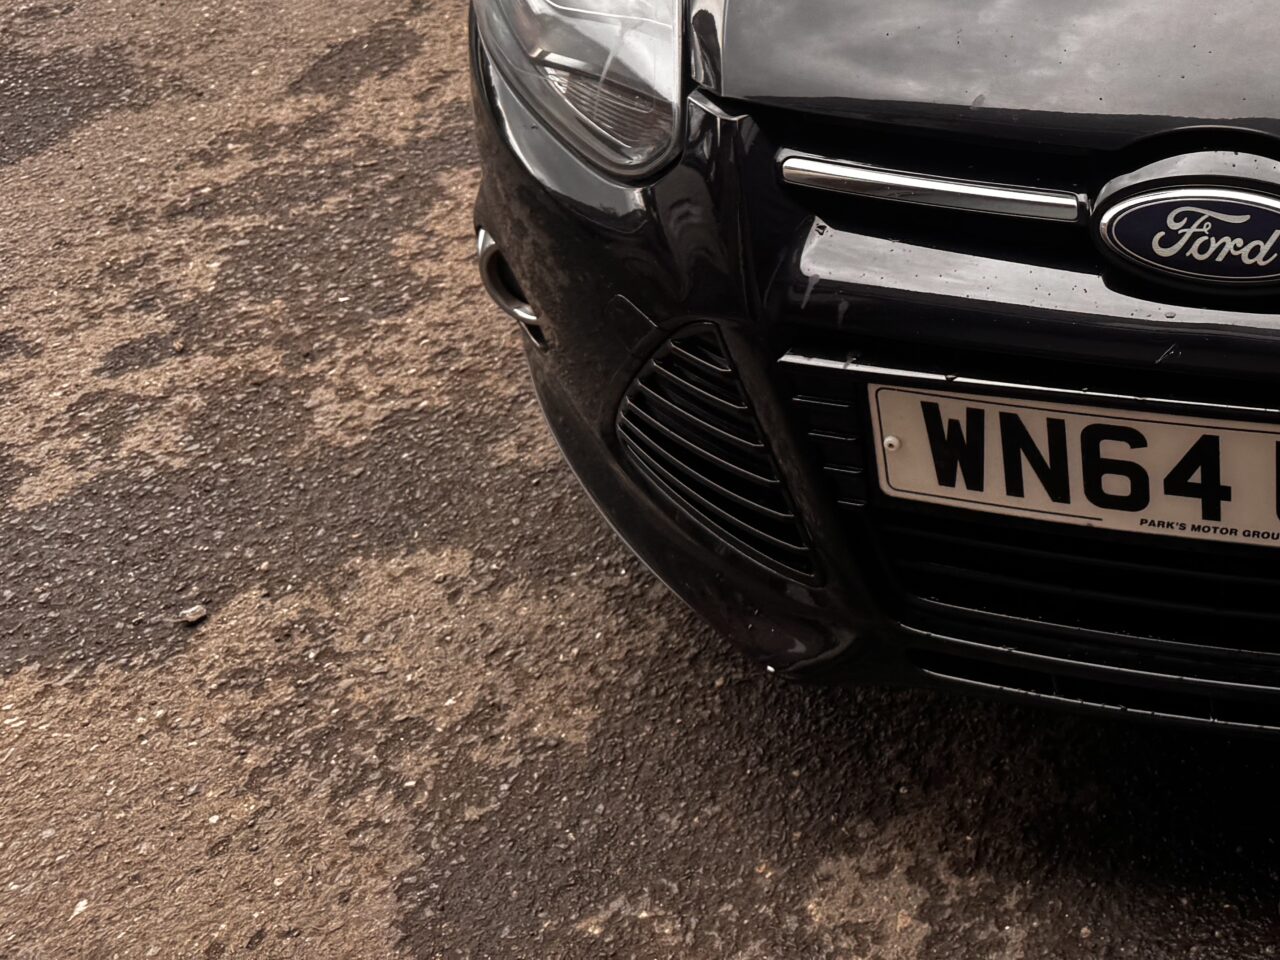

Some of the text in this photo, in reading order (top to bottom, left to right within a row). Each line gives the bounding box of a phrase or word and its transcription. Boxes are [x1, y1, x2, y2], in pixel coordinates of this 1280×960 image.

[919, 400, 1232, 522] WN64
[1139, 518, 1187, 531] PARK'S
[1190, 524, 1239, 537] MOTOR
